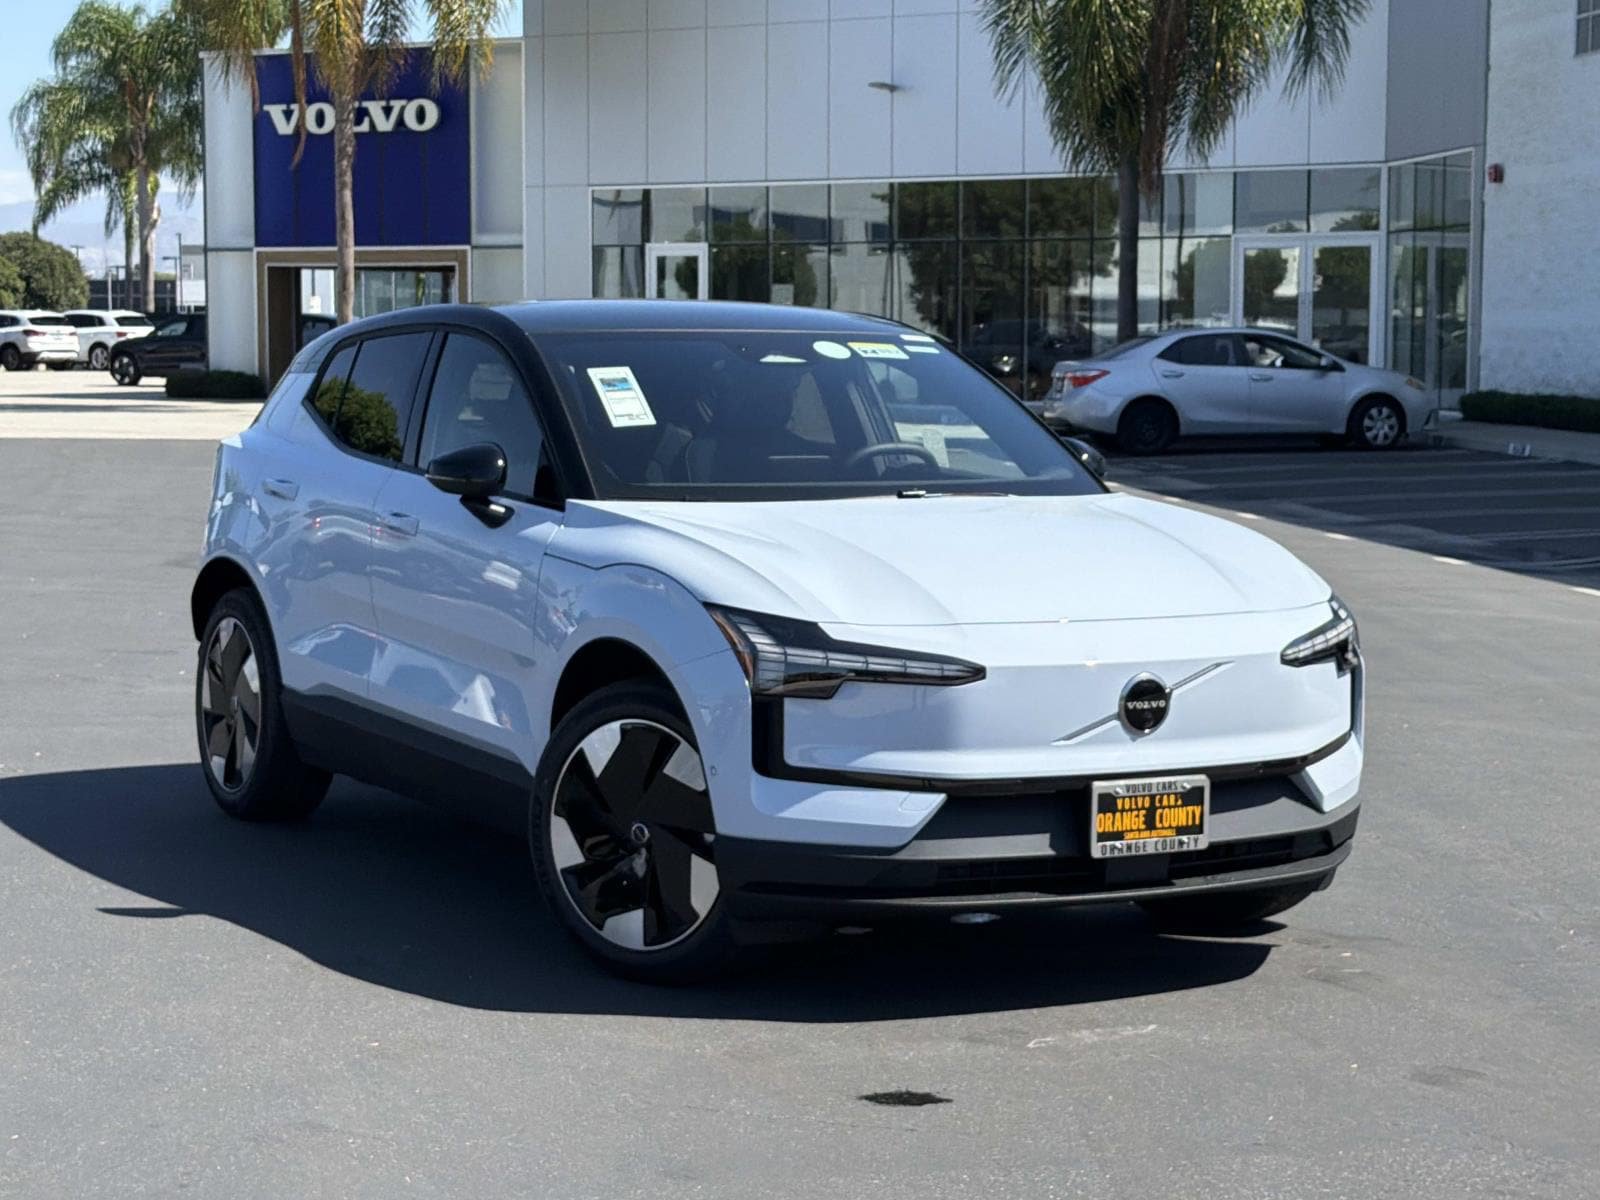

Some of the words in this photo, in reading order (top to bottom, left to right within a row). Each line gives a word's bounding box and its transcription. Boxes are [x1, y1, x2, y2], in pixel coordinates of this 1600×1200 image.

[1126, 699, 1167, 710] VOLVO
[1125, 783, 1153, 794] VOLVO
[1156, 781, 1178, 792] CARS
[1116, 796, 1151, 810] VOLVO
[1096, 810, 1147, 833] ORANGE
[1155, 805, 1202, 828] COUNTY
